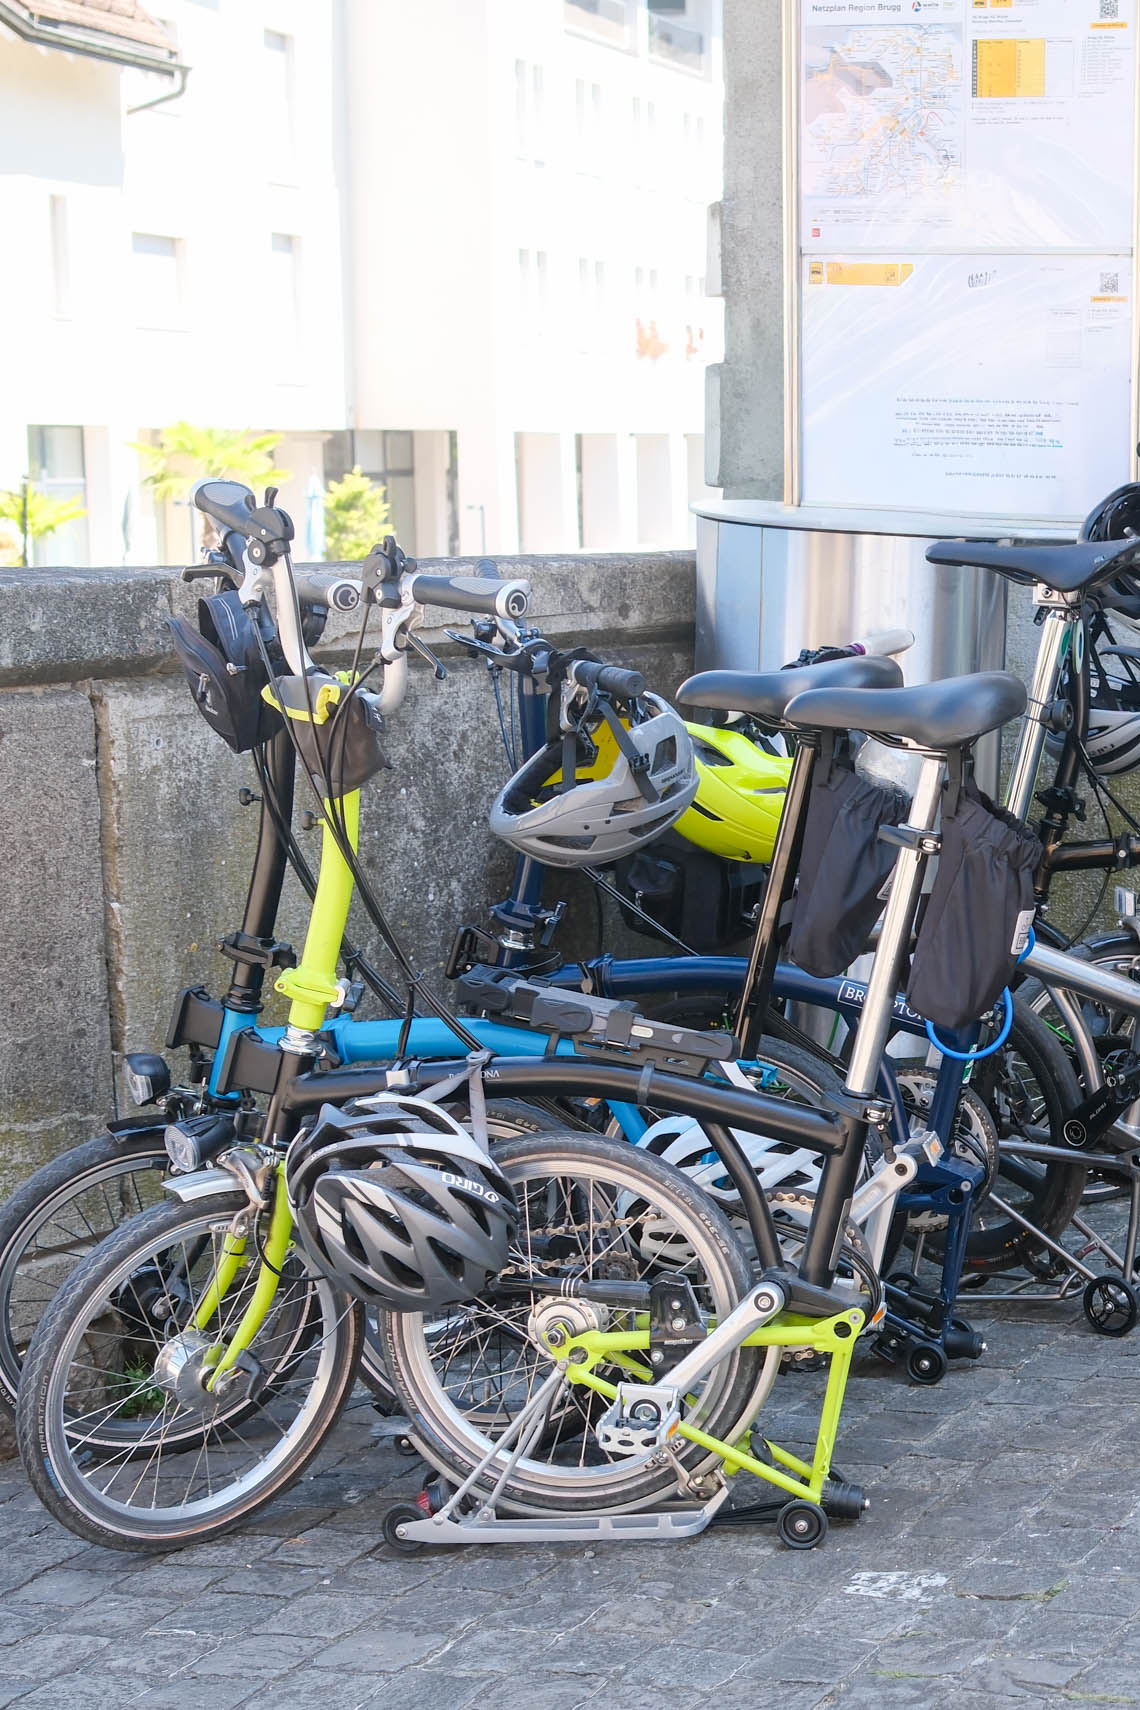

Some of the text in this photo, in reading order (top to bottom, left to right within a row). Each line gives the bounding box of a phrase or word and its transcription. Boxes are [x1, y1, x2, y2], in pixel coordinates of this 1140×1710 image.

[812, 3, 901, 13] Netzplan Region Brugg
[441, 1172, 484, 1195] GIRO
[386, 1333, 417, 1409] MARATHON
